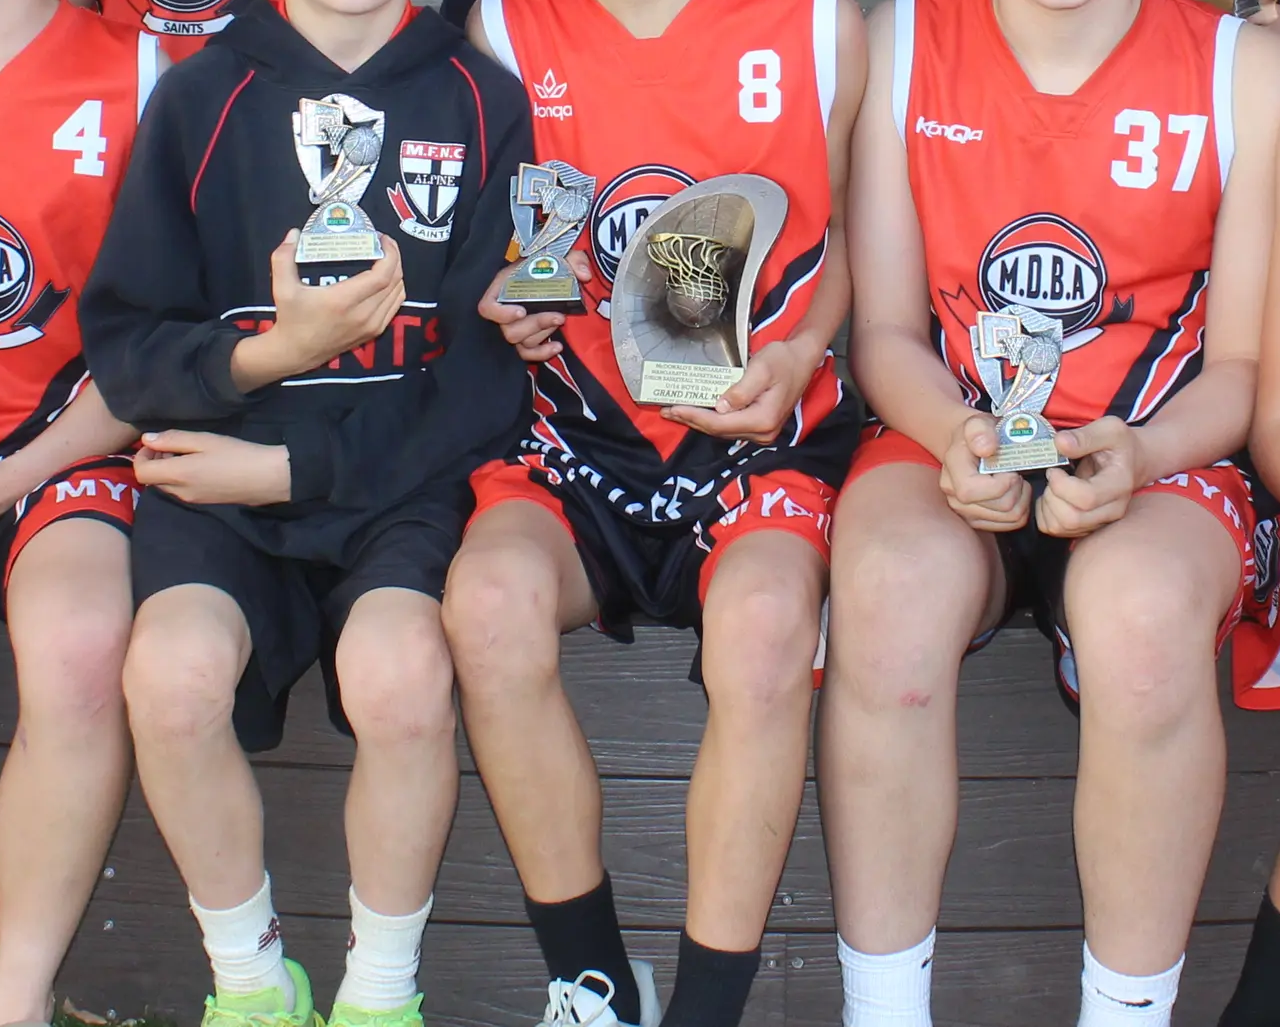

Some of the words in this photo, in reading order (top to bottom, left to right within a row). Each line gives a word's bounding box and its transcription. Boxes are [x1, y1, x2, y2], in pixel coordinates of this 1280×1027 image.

[163, 21, 204, 34] SAINTS
[739, 49, 782, 123] 8
[52, 100, 107, 176] 4
[1110, 109, 1209, 192] 37
[413, 174, 456, 187] ALPINE
[999, 253, 1085, 301] M.D.B.A
[653, 389, 683, 398] GRAND
[685, 391, 709, 400] FINAL
